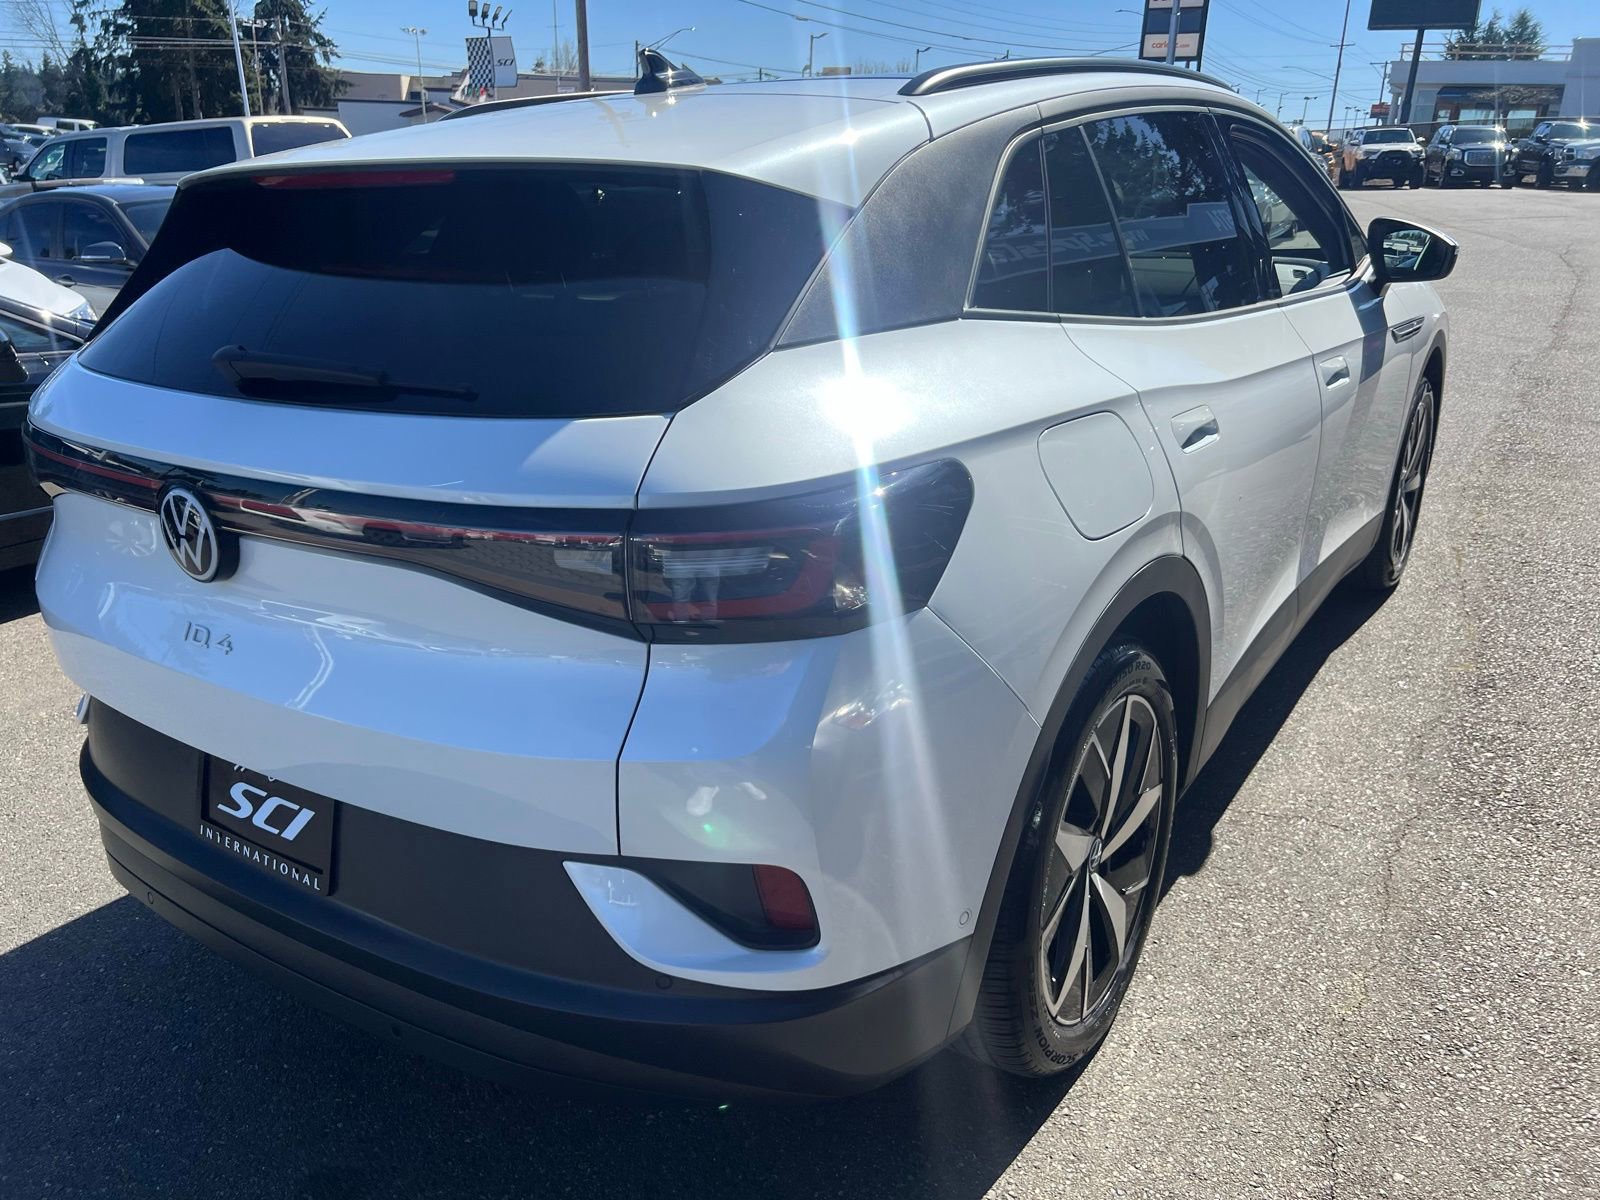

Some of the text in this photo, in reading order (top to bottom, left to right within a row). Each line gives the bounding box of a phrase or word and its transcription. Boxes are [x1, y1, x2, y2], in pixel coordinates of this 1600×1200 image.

[495, 58, 514, 67] SCI
[160, 487, 218, 582] VW
[217, 782, 316, 841] SCI
[200, 824, 321, 891] INTERNATIONAL
[1033, 1026, 1079, 1066] SCORPION
